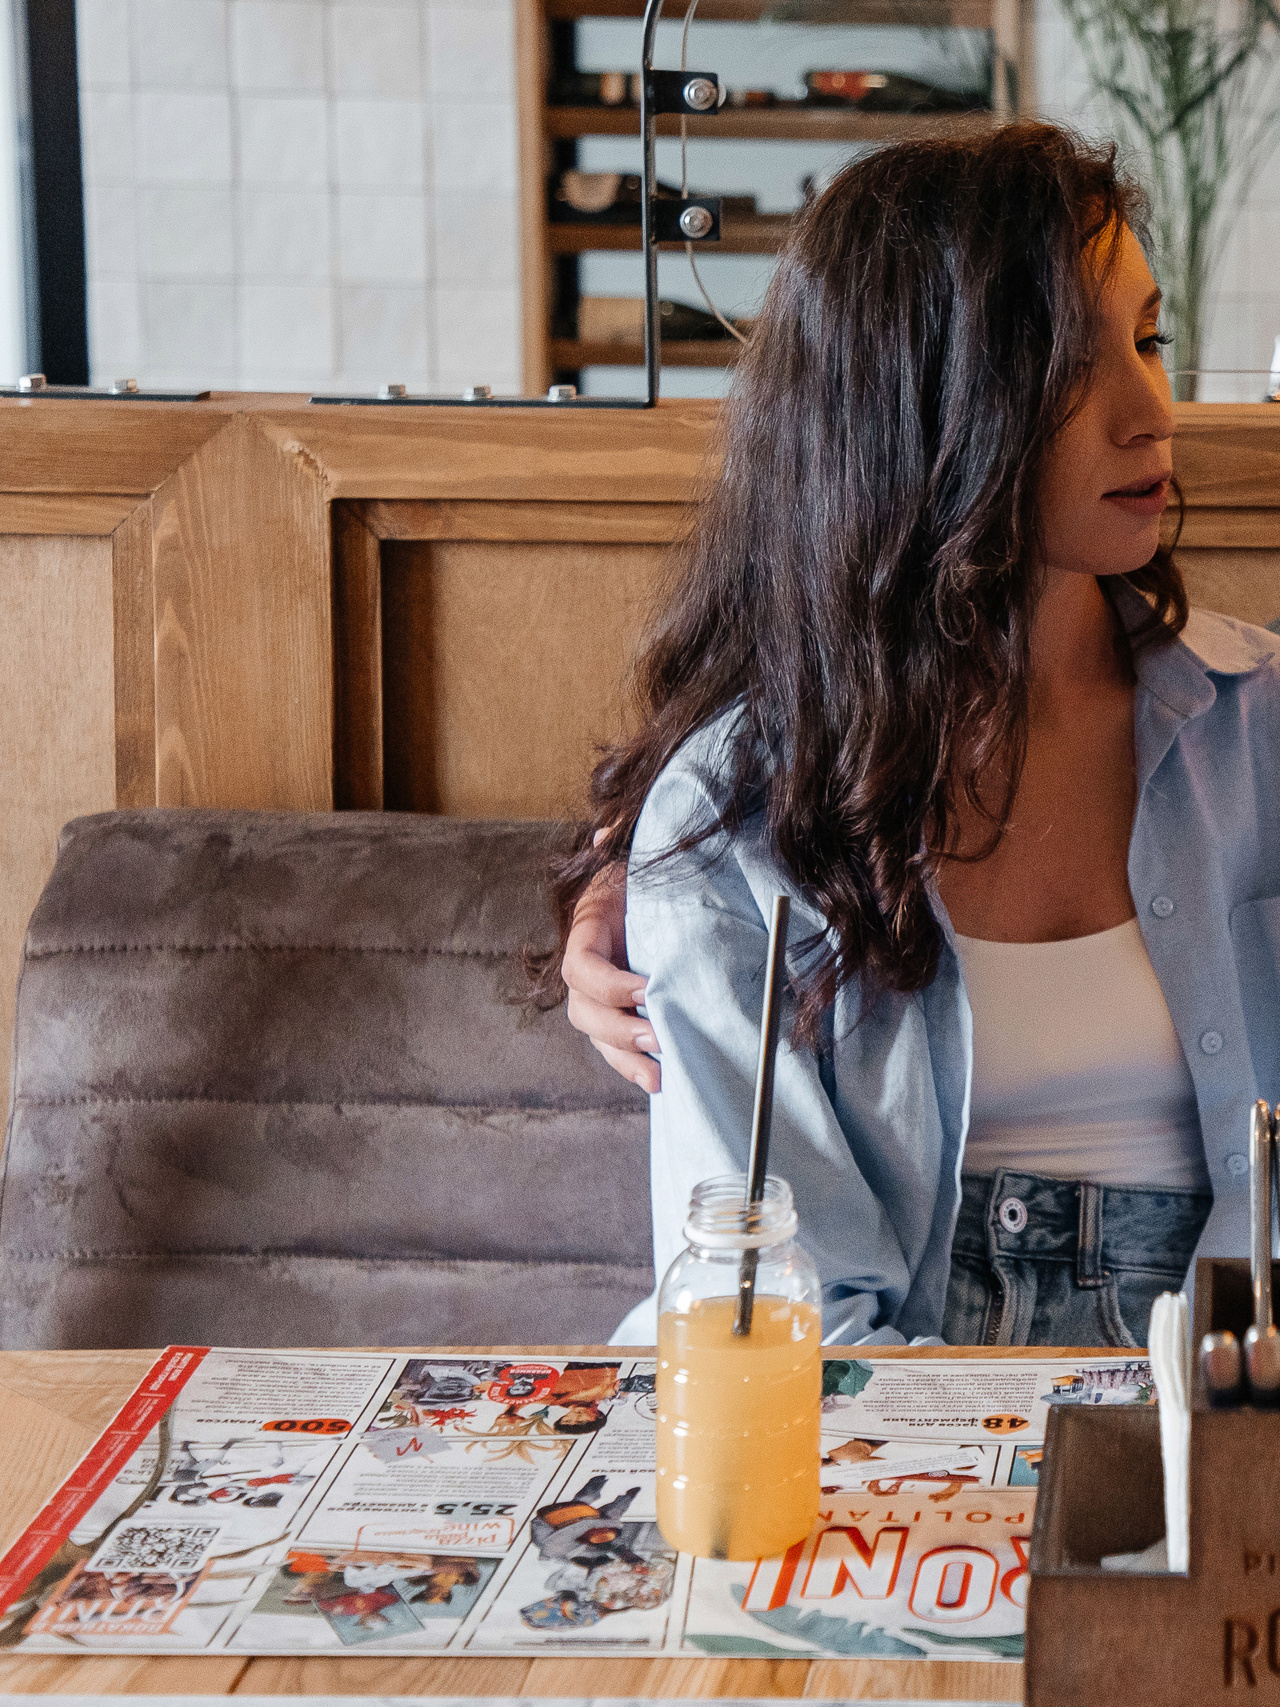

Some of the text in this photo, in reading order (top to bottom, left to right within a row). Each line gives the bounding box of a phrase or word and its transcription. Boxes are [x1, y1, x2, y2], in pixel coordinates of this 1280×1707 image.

[274, 1420, 349, 1432] 500
[982, 1418, 1029, 1429] 48
[434, 1502, 518, 1516] 25,5
[819, 1511, 1025, 1523] POLITAN
[443, 1522, 501, 1531] wine
[438, 1534, 496, 1546] pizza
